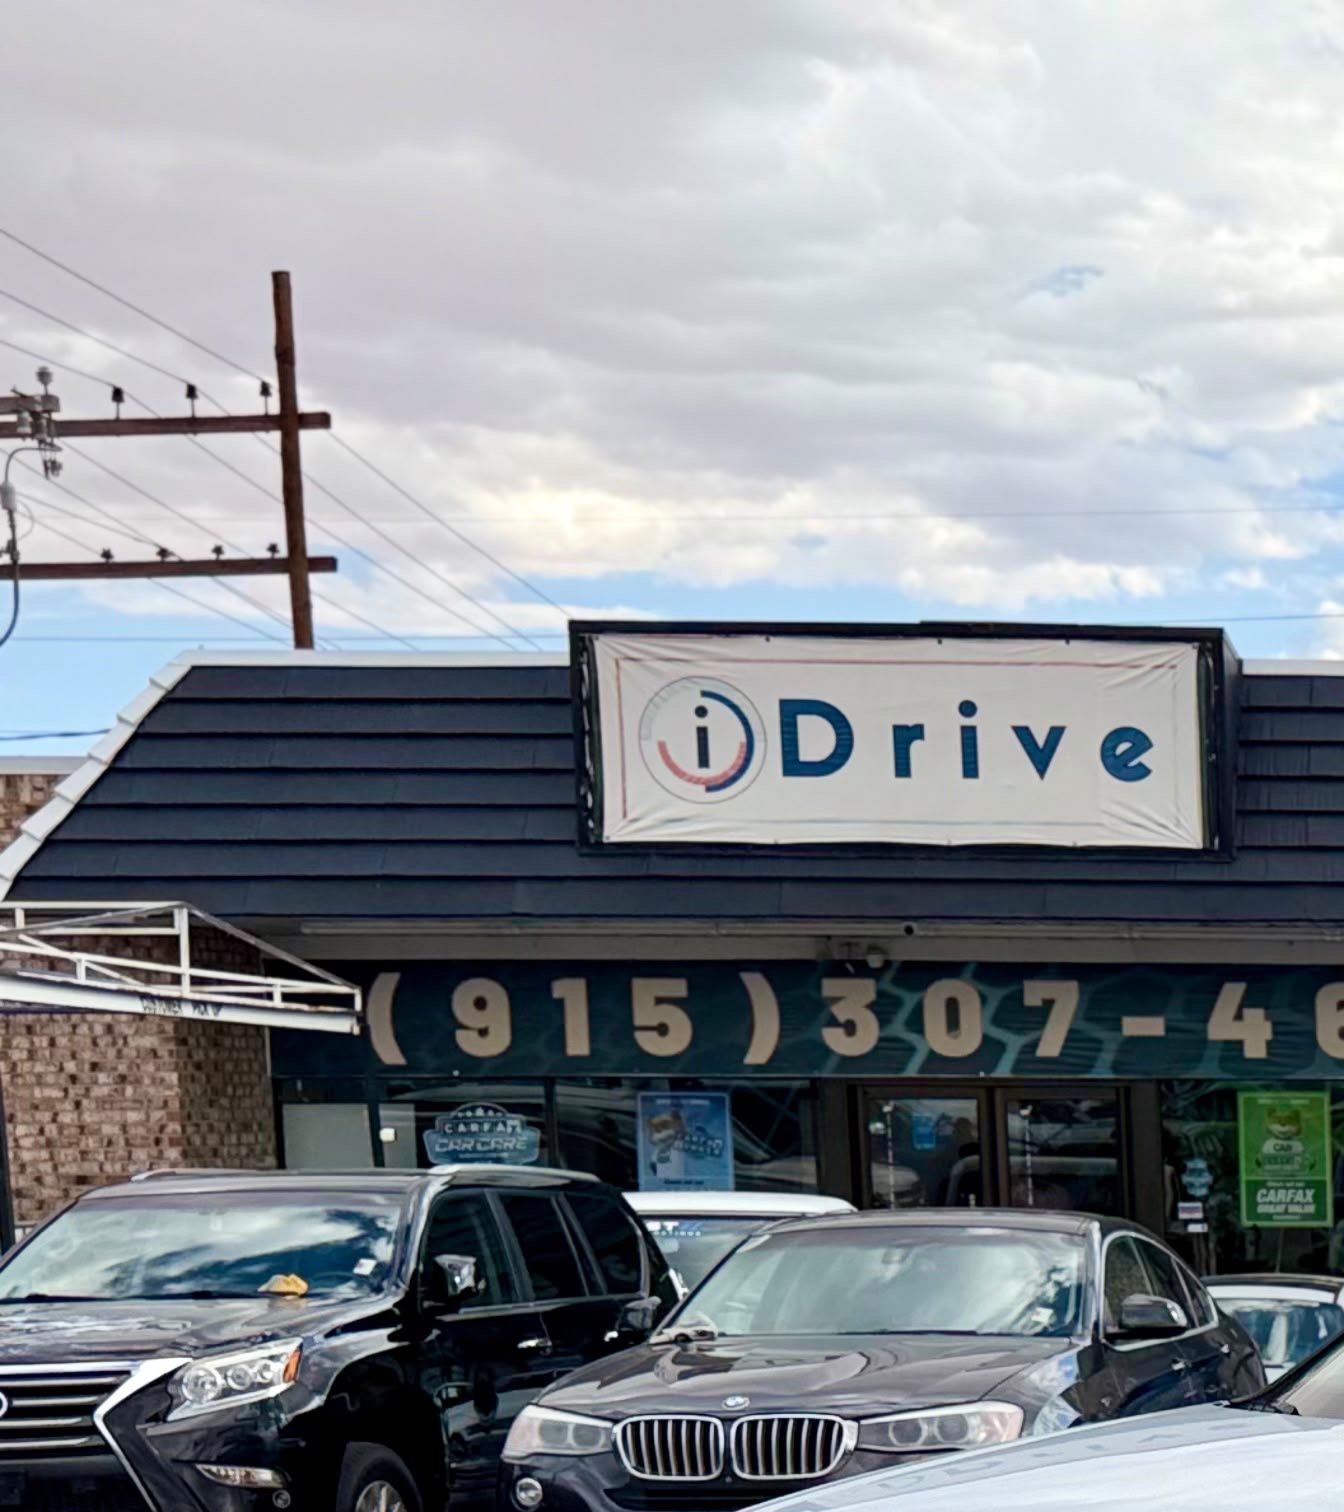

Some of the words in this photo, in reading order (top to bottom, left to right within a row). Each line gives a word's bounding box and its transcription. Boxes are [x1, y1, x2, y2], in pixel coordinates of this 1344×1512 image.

[435, 1138, 475, 1153] CAR
[476, 1137, 528, 1151] CARE
[1256, 1188, 1316, 1204] CARFAX
